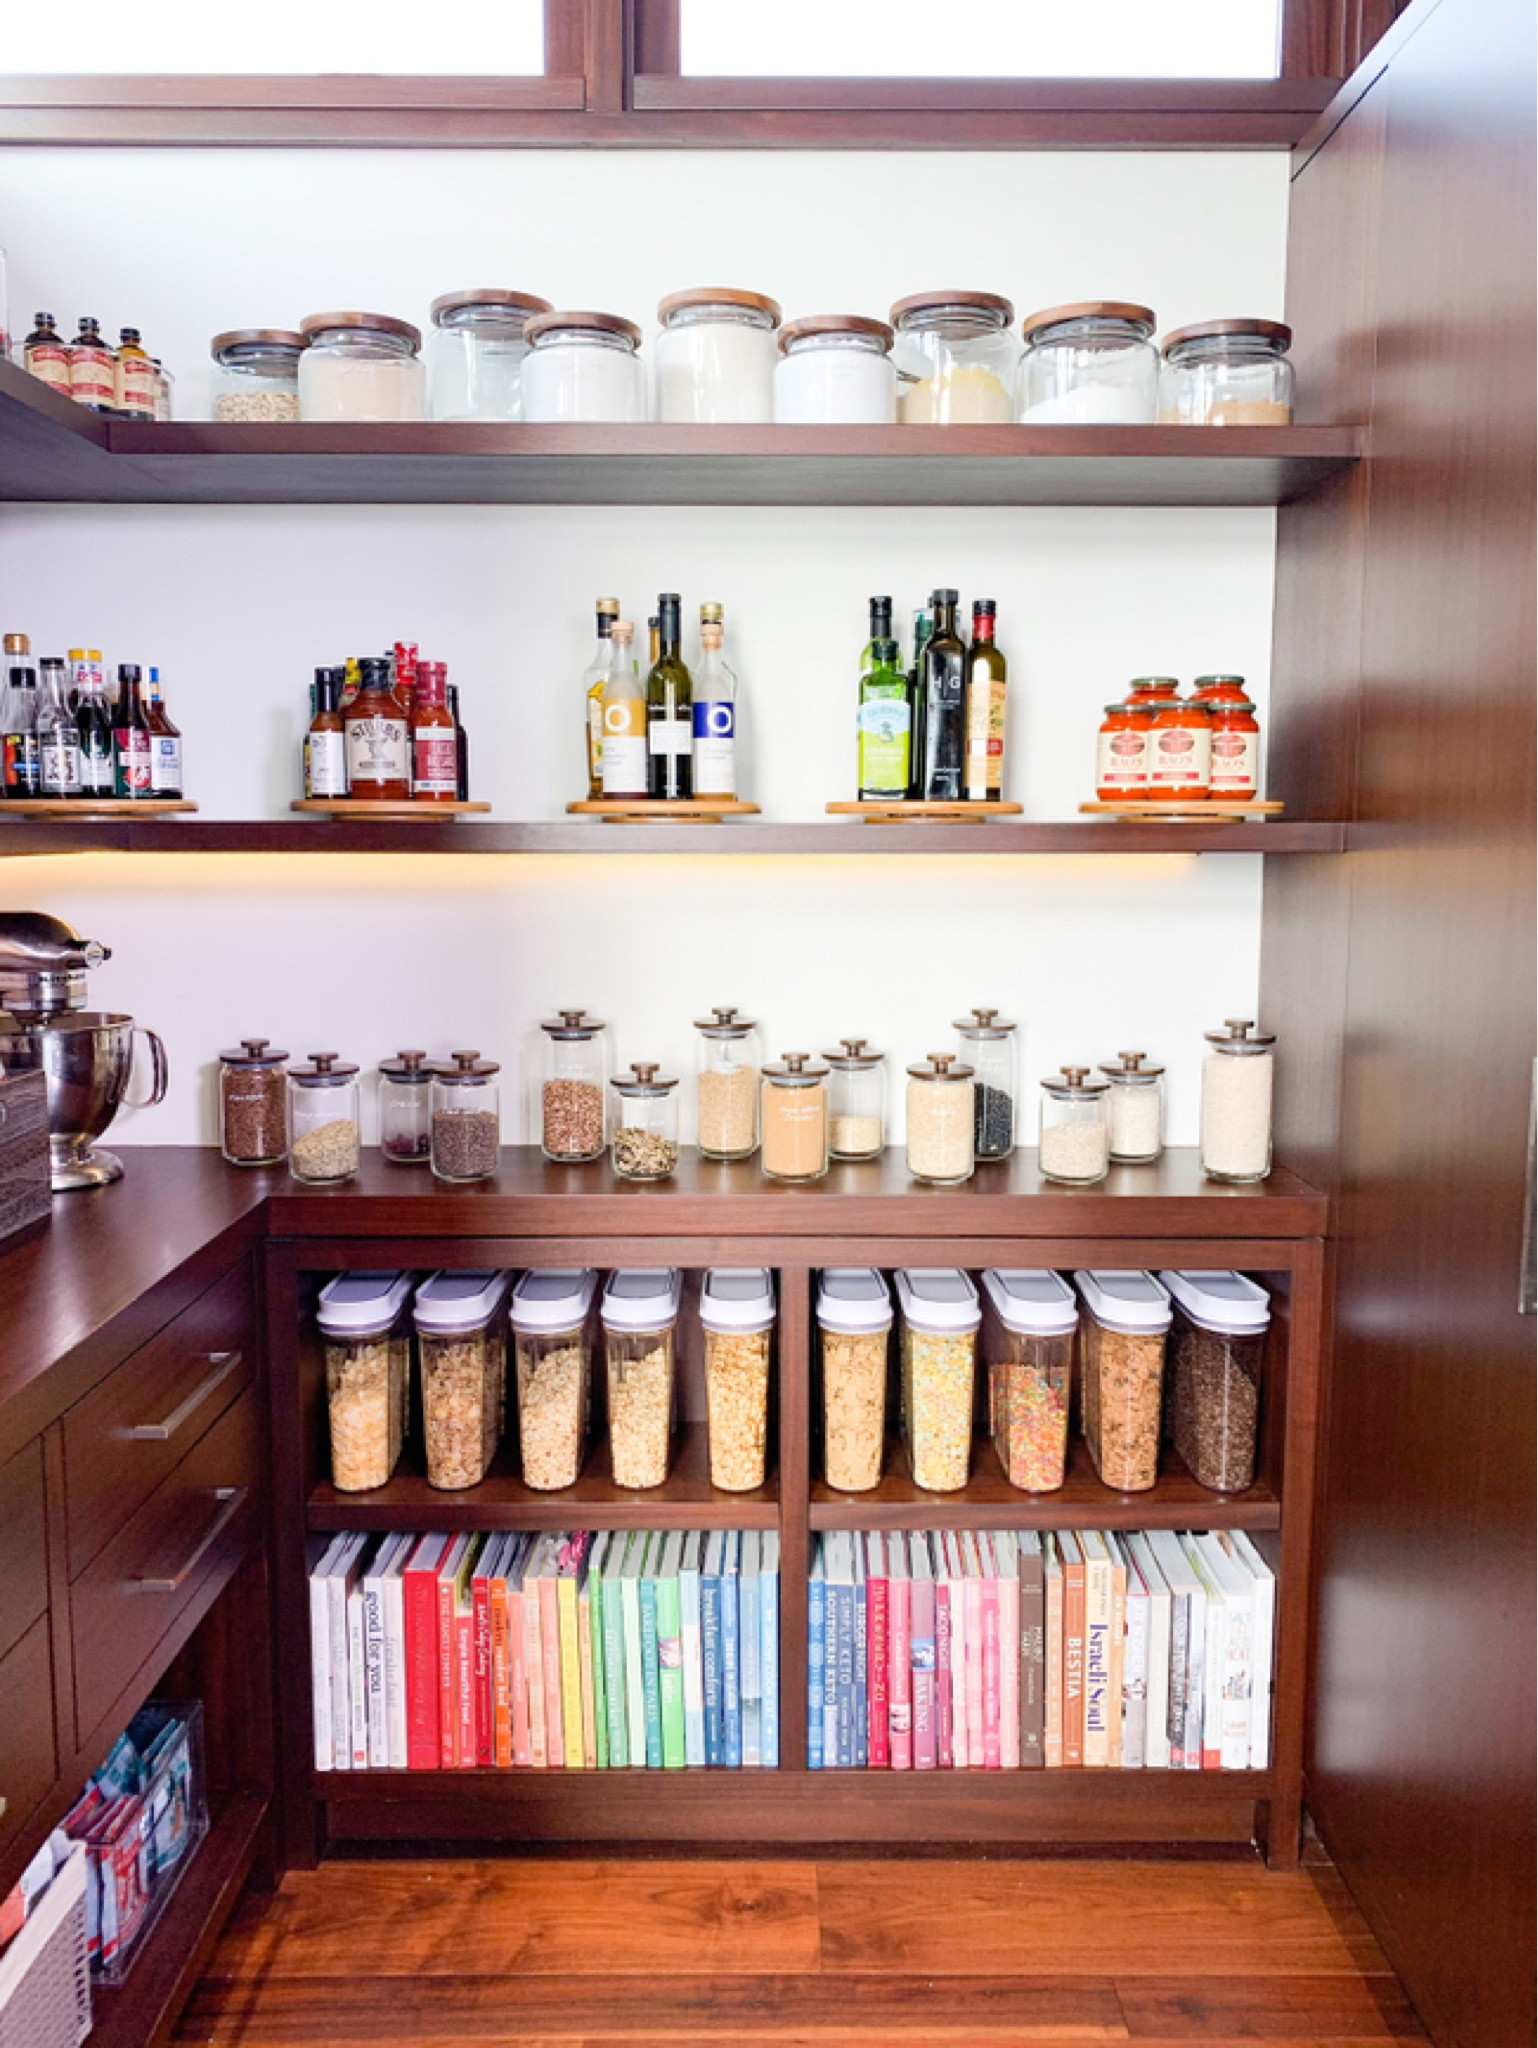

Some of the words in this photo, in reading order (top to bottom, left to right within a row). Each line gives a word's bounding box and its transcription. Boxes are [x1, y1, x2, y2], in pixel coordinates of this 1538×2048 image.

[605, 704, 631, 732] O
[706, 705, 733, 733] O
[366, 1591, 382, 1632] good
[704, 1589, 719, 1648] breakfast
[825, 1589, 838, 1664] SOUTHERN
[839, 1595, 852, 1642] SIMPLY
[855, 1602, 867, 1648] BURGER
[938, 1604, 949, 1635] TACO
[368, 1636, 385, 1660] for
[643, 1604, 656, 1666] BAREFOOT
[1089, 1624, 1109, 1684] Israeli
[366, 1664, 382, 1694] you
[645, 1671, 656, 1685] IN
[704, 1651, 720, 1707] comforts
[825, 1667, 838, 1704] KETO
[839, 1648, 852, 1685] KETO
[855, 1649, 867, 1684] NIGHT
[1067, 1636, 1082, 1698] BESTIA
[648, 1689, 658, 1723] PARIS
[915, 1673, 929, 1733] BAKING
[1087, 1687, 1107, 1732] Soul
